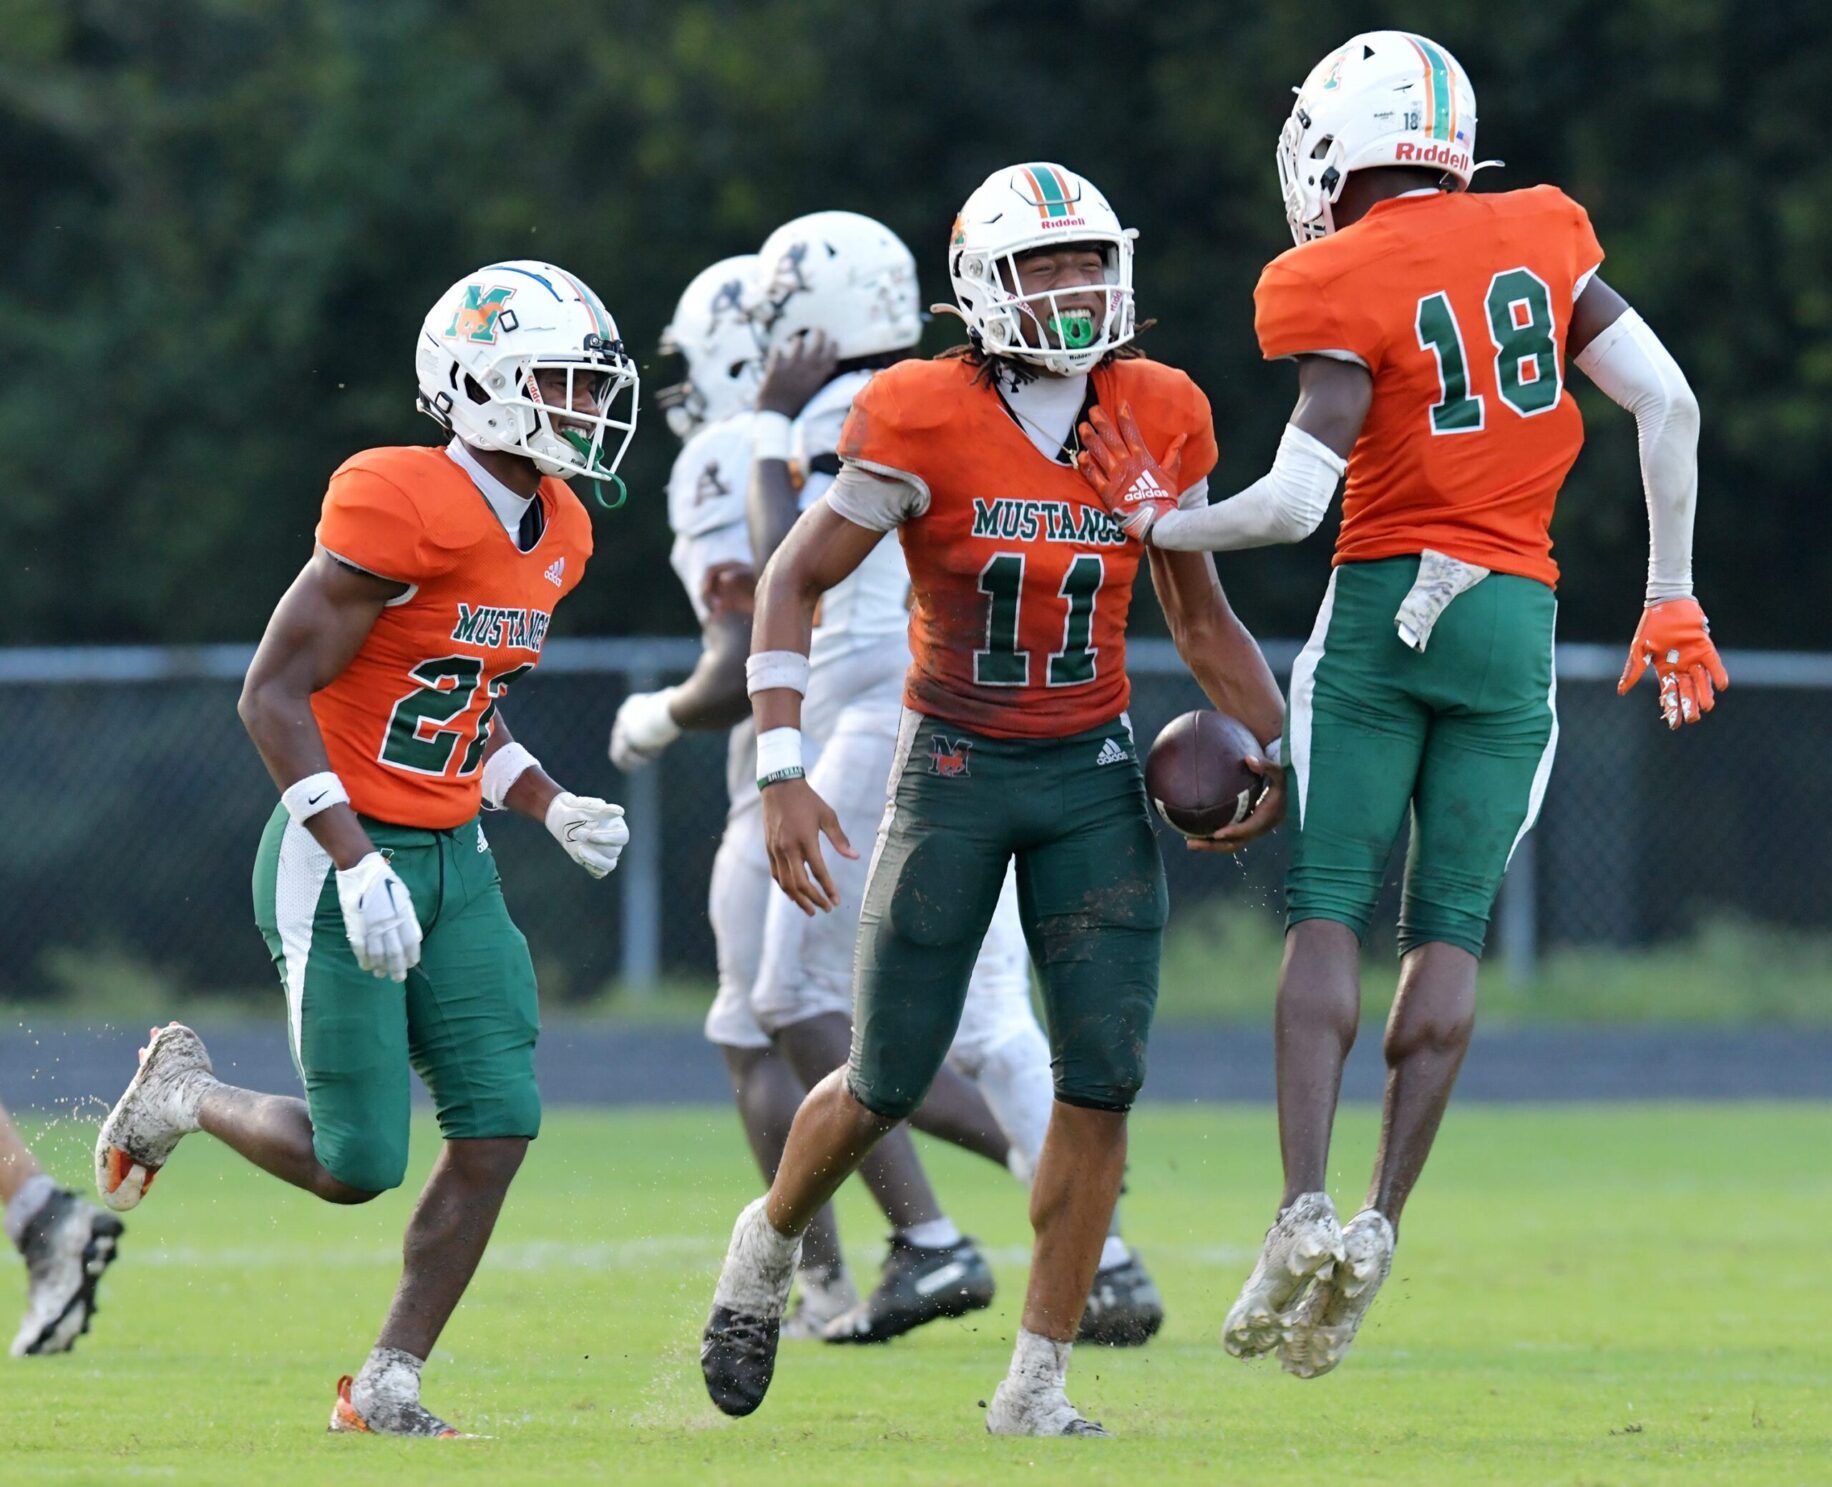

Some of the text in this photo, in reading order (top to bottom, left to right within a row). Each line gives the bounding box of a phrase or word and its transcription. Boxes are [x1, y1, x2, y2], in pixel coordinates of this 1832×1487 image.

[1403, 112, 1418, 131] 18
[1395, 142, 1469, 171] Riddell
[1041, 217, 1086, 230] Riddell
[1414, 266, 1563, 436] 18
[1124, 487, 1169, 502] adidas
[971, 498, 1128, 546] MUSTANGS
[971, 551, 1104, 688] 11
[1096, 750, 1128, 766] adidas
